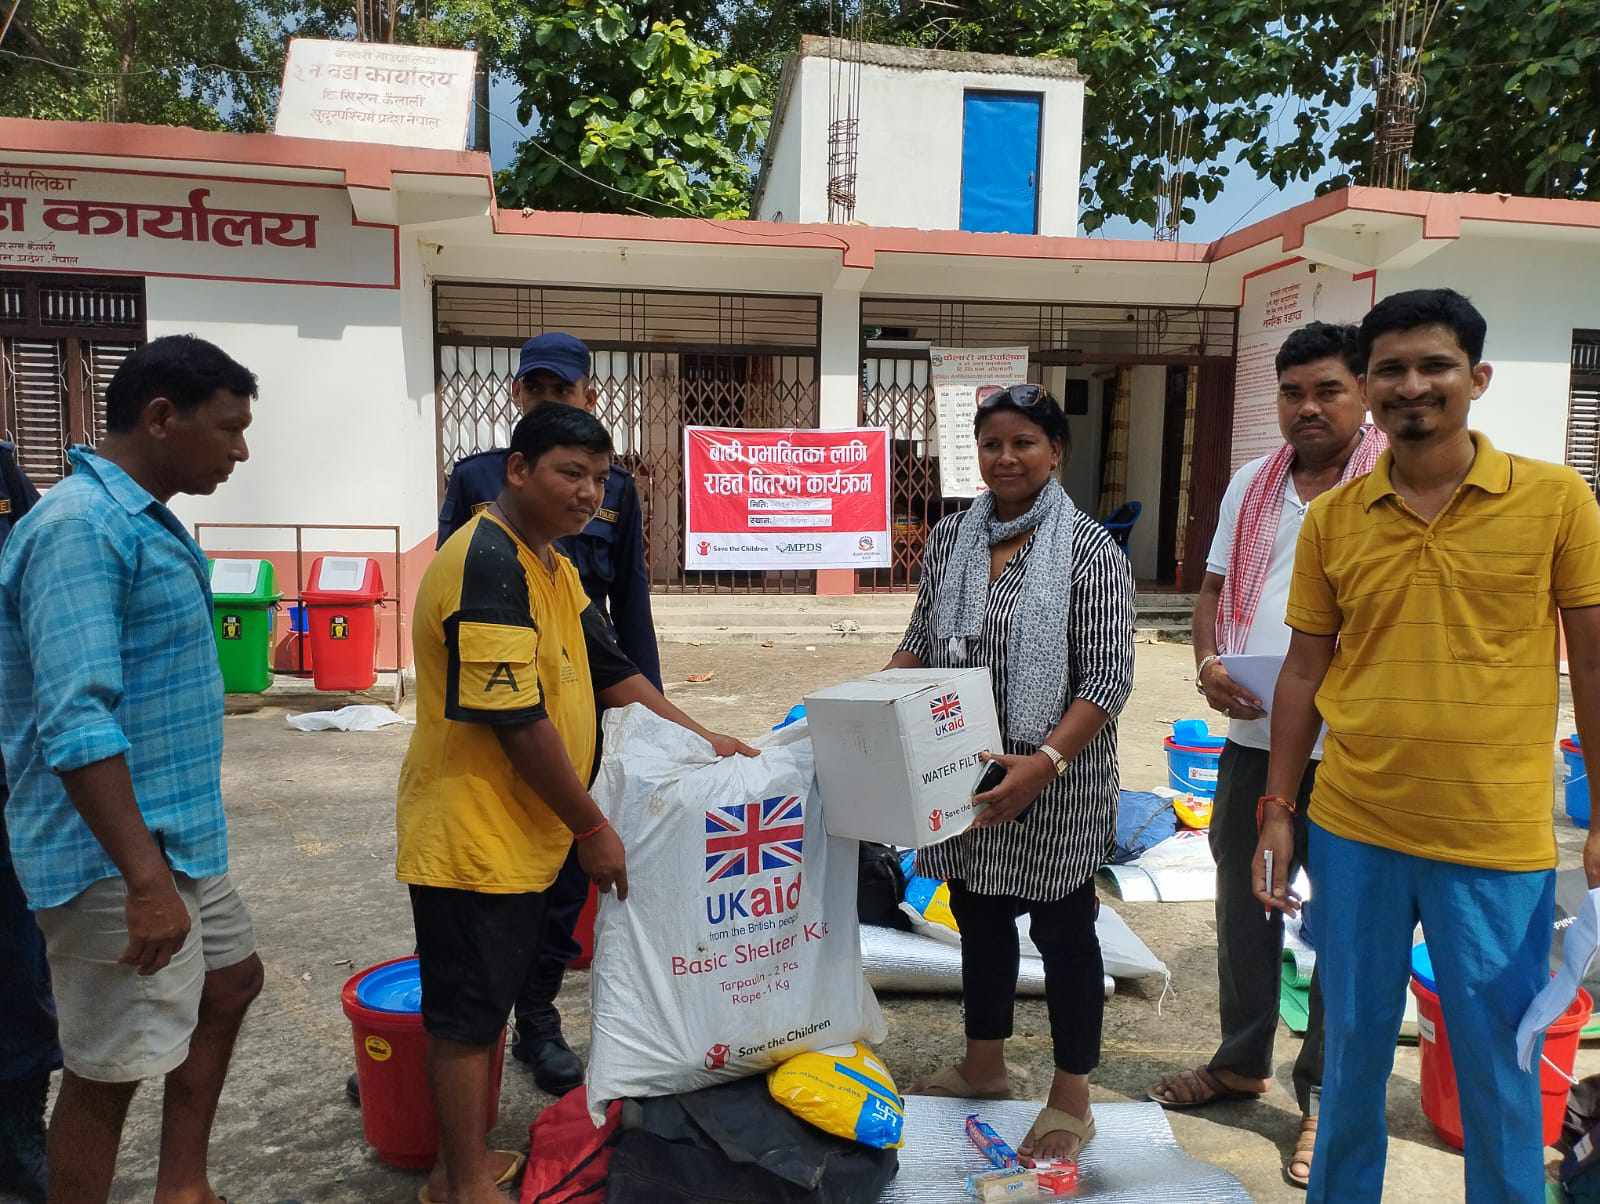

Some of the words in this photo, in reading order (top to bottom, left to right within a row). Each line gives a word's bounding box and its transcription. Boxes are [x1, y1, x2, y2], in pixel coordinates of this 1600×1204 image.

[42, 189, 319, 249] कार्यालय
[829, 439, 868, 464] लागि
[703, 473, 745, 495] राहत
[748, 467, 801, 495] वितरण
[806, 469, 873, 495] कार्यक्रम
[787, 543, 823, 552] MPDS
[484, 662, 520, 692] A
[935, 715, 965, 736] UKaid
[922, 762, 957, 785] WATER
[959, 749, 990, 770] FILTE
[944, 809, 960, 820] Save
[707, 871, 802, 924] UKaid
[709, 930, 729, 942] from
[731, 926, 746, 937] the
[748, 919, 776, 934] British
[671, 952, 728, 976] Basic
[735, 934, 798, 964] Shelter
[804, 919, 830, 942] Kit
[783, 960, 799, 971] Pcs
[732, 991, 761, 1005] Rope
[775, 979, 790, 991] Kg
[738, 1044, 766, 1058] Save
[767, 1036, 786, 1050] the
[787, 1018, 831, 1042] Children
